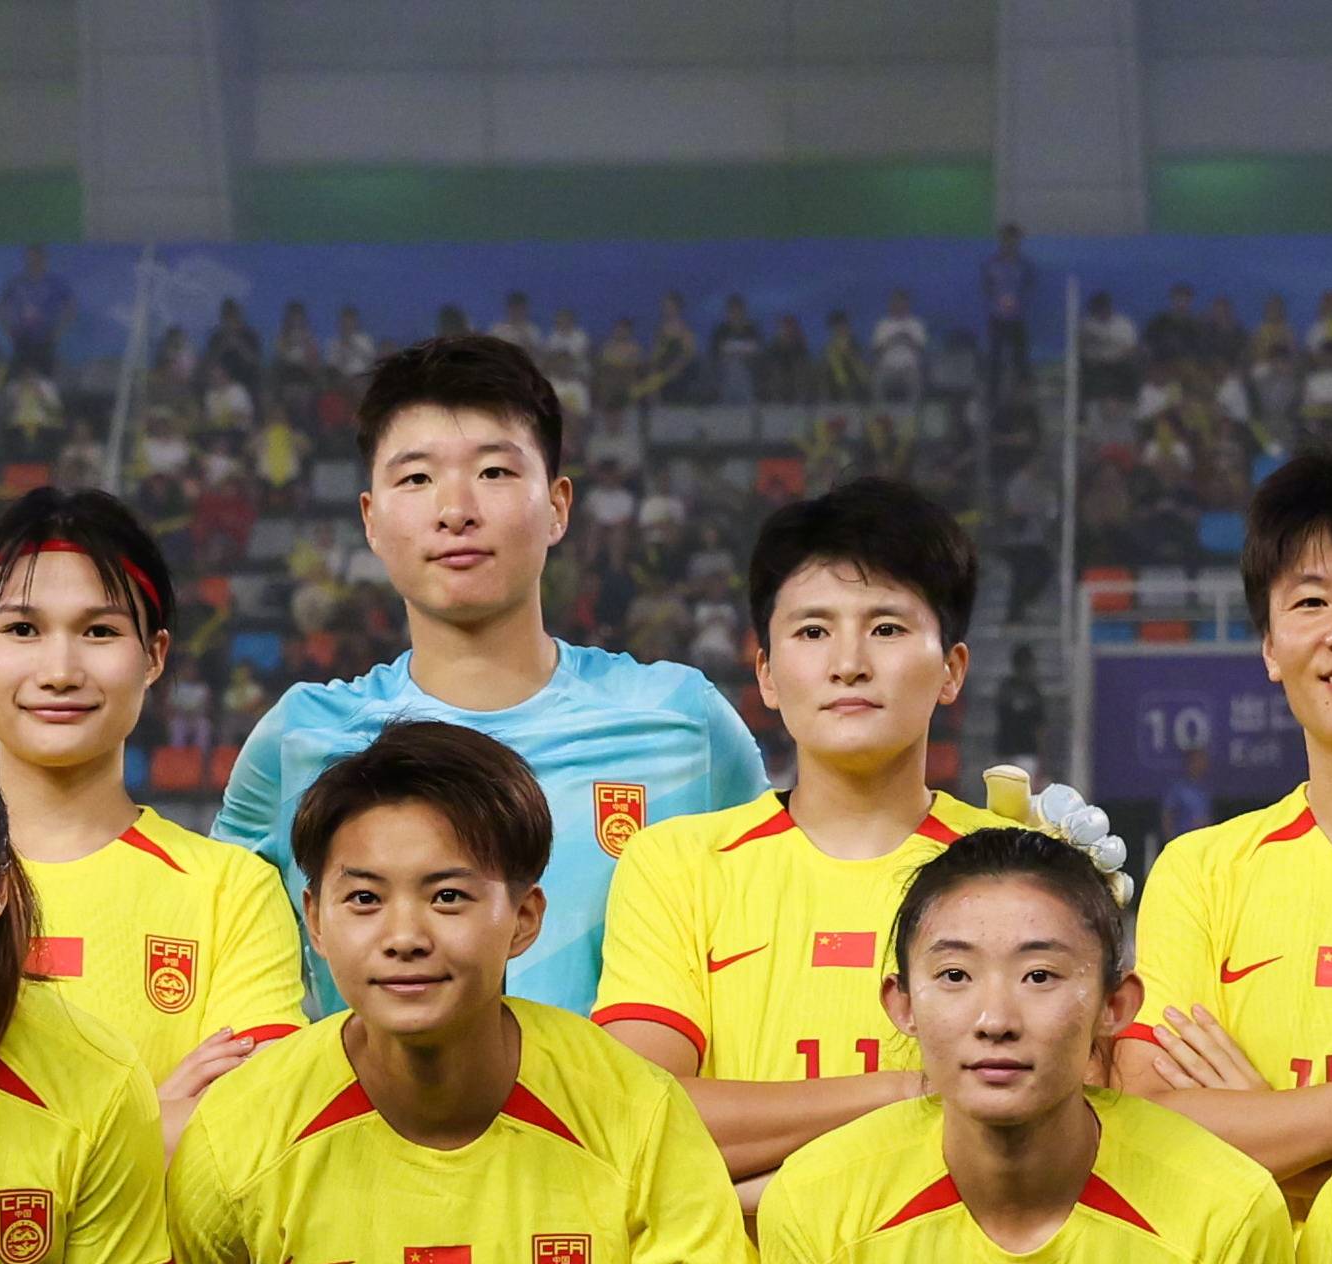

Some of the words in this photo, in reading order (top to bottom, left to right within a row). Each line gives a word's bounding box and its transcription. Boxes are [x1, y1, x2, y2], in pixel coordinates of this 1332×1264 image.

[1144, 705, 1211, 753] 10
[600, 789, 640, 803] CFA
[151, 942, 192, 959] CFA
[1, 1197, 46, 1211] CFA
[539, 1241, 584, 1256] CFA
